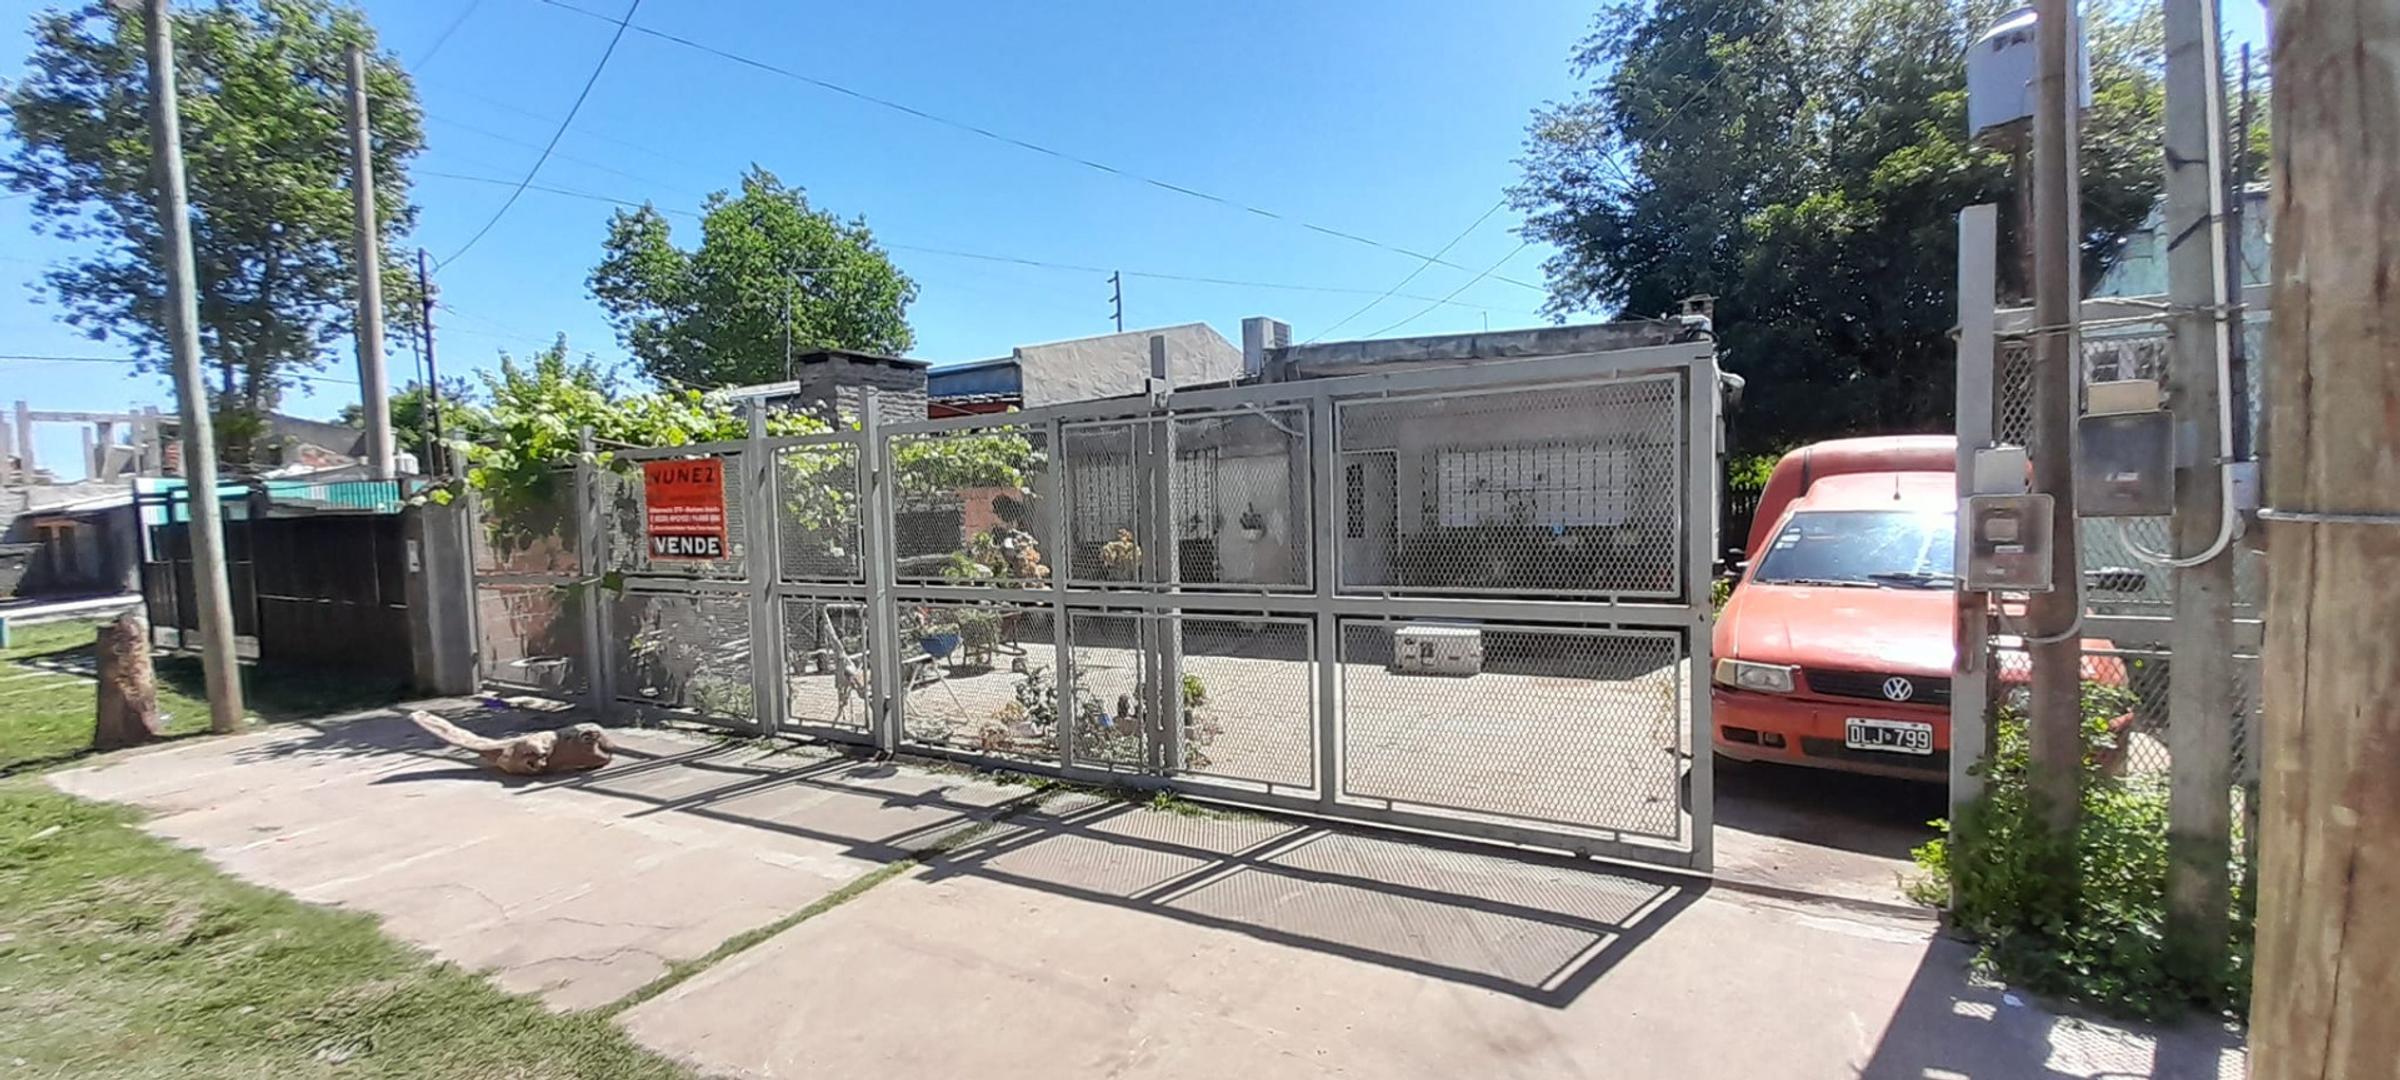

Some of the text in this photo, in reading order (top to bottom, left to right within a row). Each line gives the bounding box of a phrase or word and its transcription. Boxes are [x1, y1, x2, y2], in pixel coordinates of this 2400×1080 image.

[655, 536, 720, 555] VENDE
[1850, 725, 1929, 749] DLJ 799
